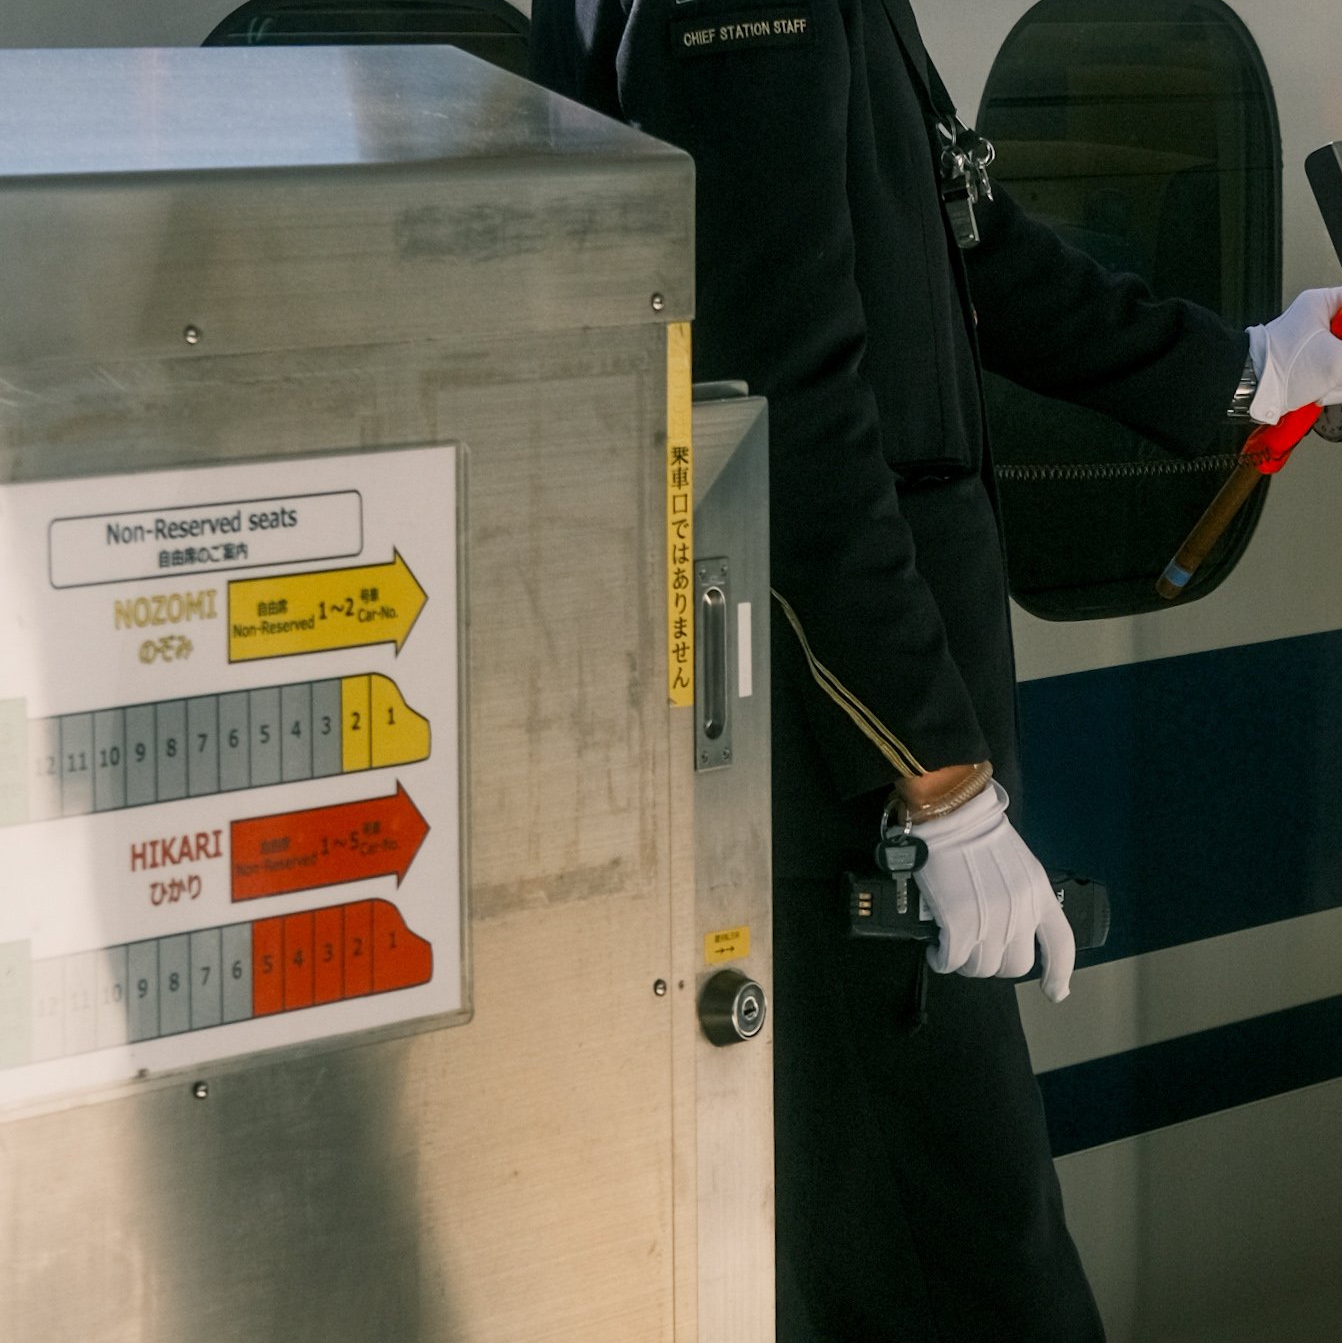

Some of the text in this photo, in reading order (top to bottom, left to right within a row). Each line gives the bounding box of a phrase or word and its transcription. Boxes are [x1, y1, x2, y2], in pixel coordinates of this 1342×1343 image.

[684, 19, 807, 47] CHIEF STATION STAFF
[106, 507, 298, 545] Non-Reserved seats
[670, 446, 690, 690] 乗車口ではありません
[114, 589, 218, 630] NOZOMI
[233, 615, 315, 638] Non-Reserved
[138, 635, 193, 665] のぞみ
[68, 752, 88, 772] 11
[100, 746, 120, 768] 10
[135, 743, 146, 763] 9
[166, 738, 177, 757] 8
[197, 734, 208, 753] 7
[229, 729, 239, 748] 6
[260, 725, 270, 744] 5
[291, 720, 301, 739] 4
[321, 716, 331, 735] 3
[351, 712, 361, 730] 2
[388, 708, 395, 725] 1
[130, 830, 222, 872] HIKARI
[150, 874, 202, 906] ひかり
[138, 979, 148, 998] 9
[169, 972, 180, 992] 8
[201, 967, 211, 986] 7
[232, 961, 242, 980] 6
[263, 955, 273, 974] 5
[324, 944, 333, 962] 3
[353, 938, 362, 956] 2
[389, 932, 396, 949] 1
